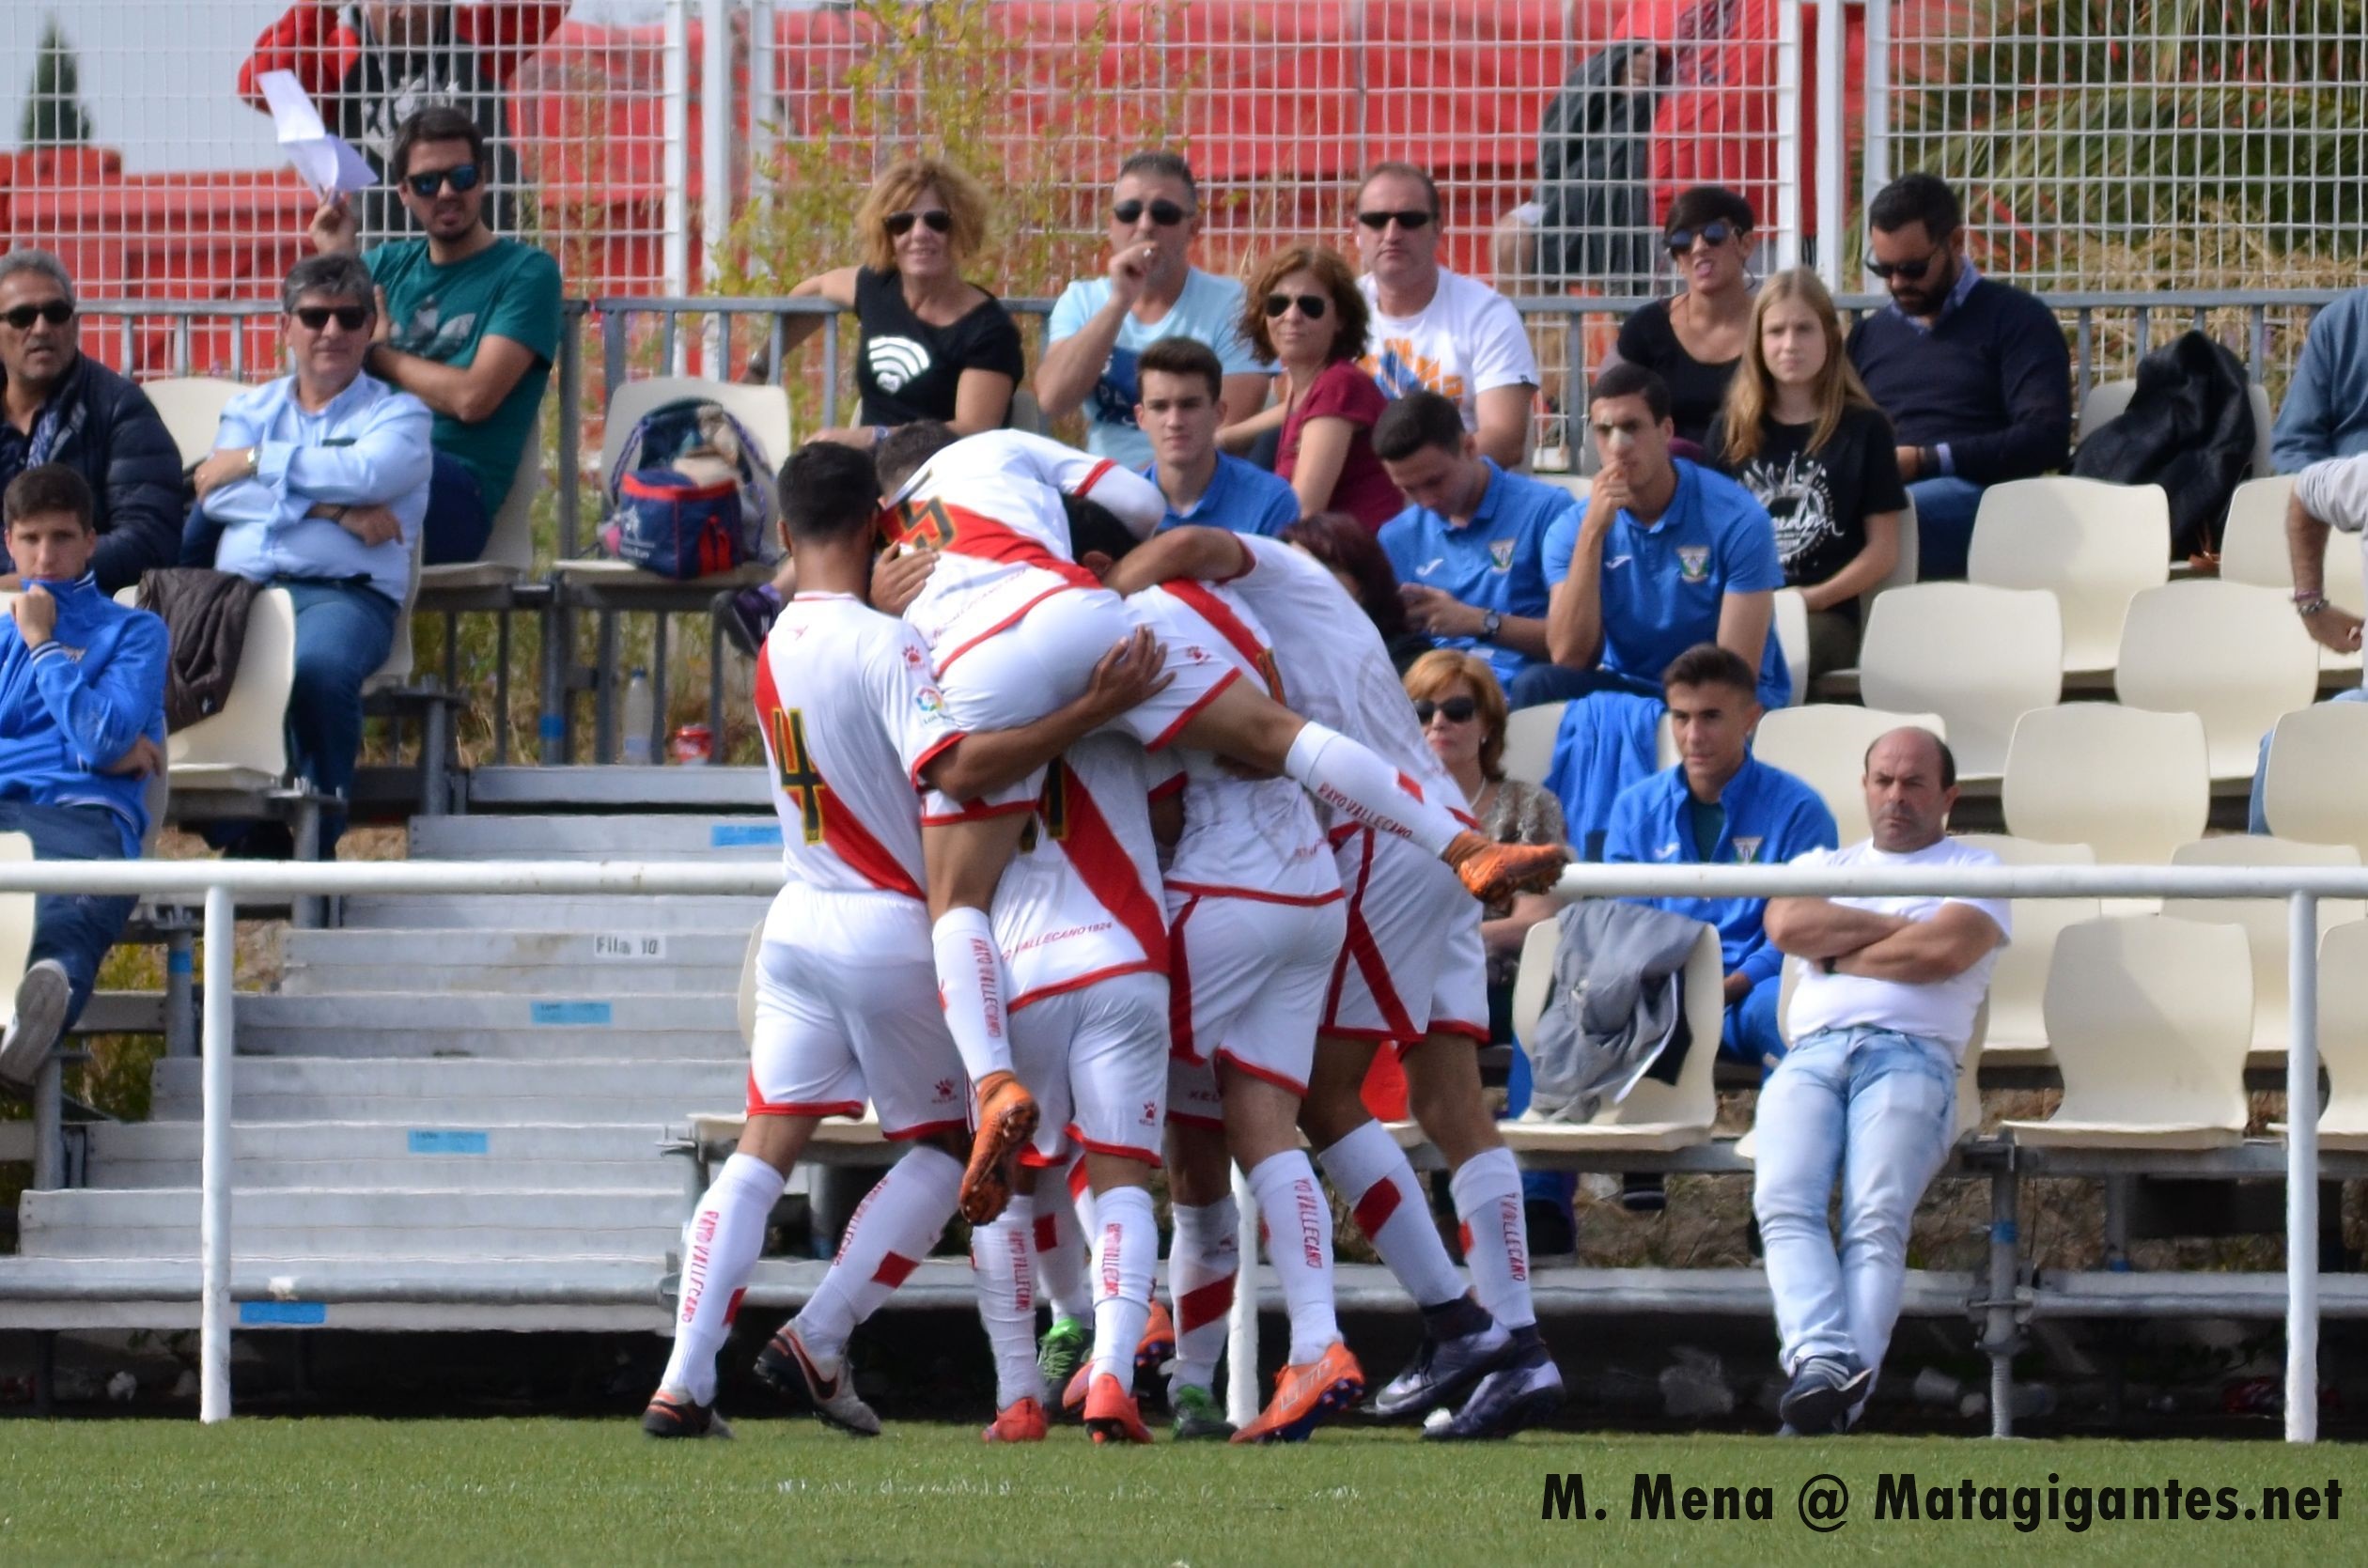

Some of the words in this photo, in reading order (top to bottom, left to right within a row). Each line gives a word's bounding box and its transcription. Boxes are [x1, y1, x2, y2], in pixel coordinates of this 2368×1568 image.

[772, 707, 825, 846] 4
[596, 937, 631, 955] Fila
[642, 939, 658, 955] 10
[977, 966, 1001, 1038] VALLECANO
[1294, 1192, 1323, 1269] VALLECANO
[1501, 1198, 1527, 1282] VALLECANO
[680, 1243, 710, 1324] VALLECANO
